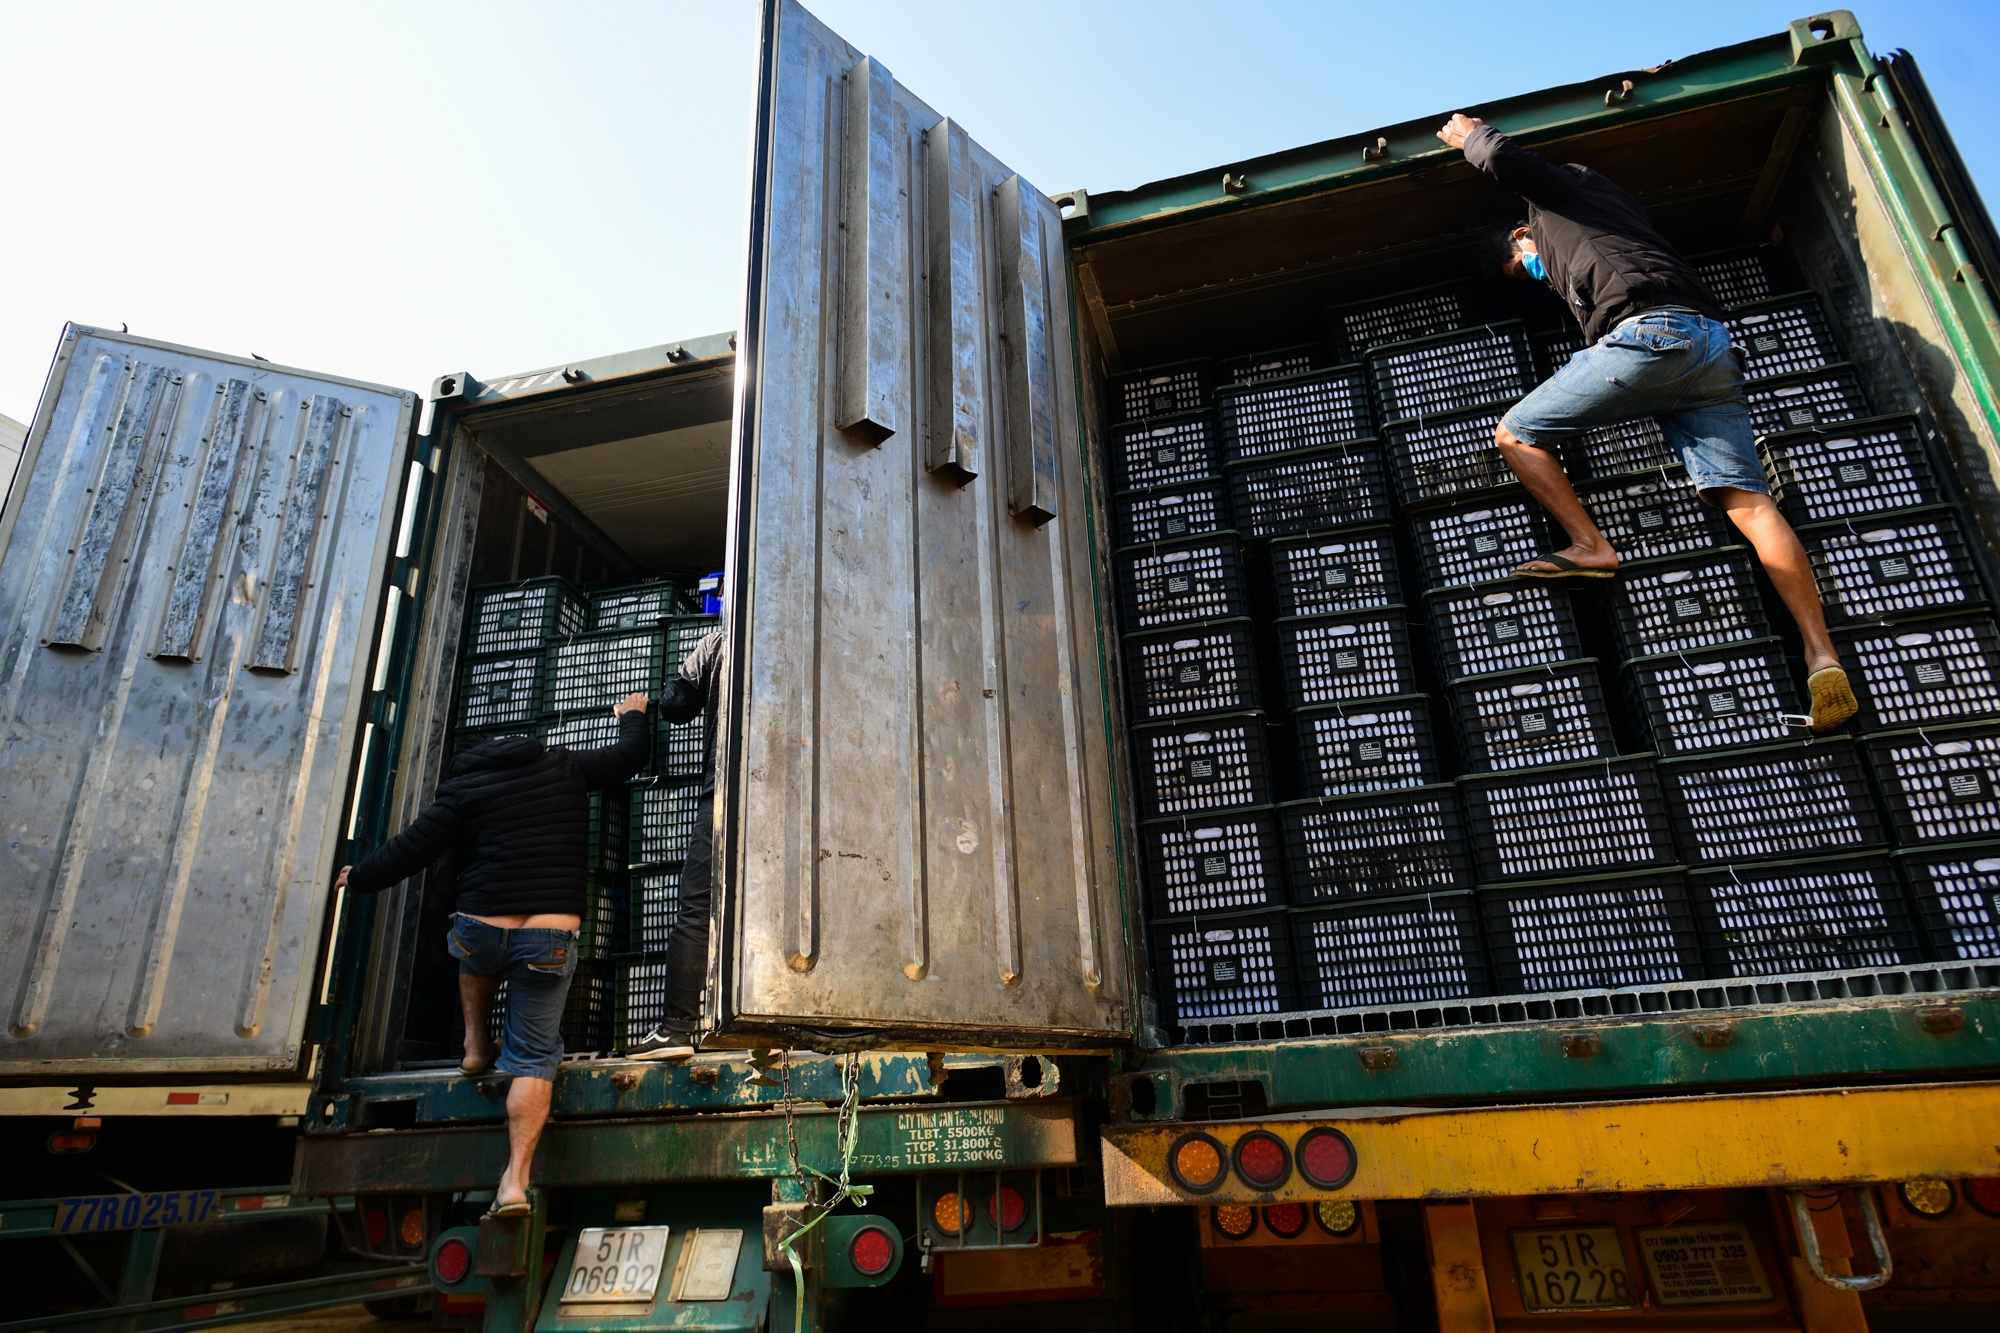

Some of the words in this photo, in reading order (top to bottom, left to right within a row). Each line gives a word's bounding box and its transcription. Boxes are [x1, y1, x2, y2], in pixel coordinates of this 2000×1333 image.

[909, 1128, 943, 1140] TLBT.
[596, 1231, 646, 1263] 51R
[1536, 1232, 1600, 1268] 51R
[1653, 1248, 1689, 1263] 0903
[1690, 1246, 1717, 1260] 777
[1719, 1244, 1748, 1259] 325
[1068, 1268, 1082, 1279] 3M
[1526, 1268, 1632, 1306] 162.28
